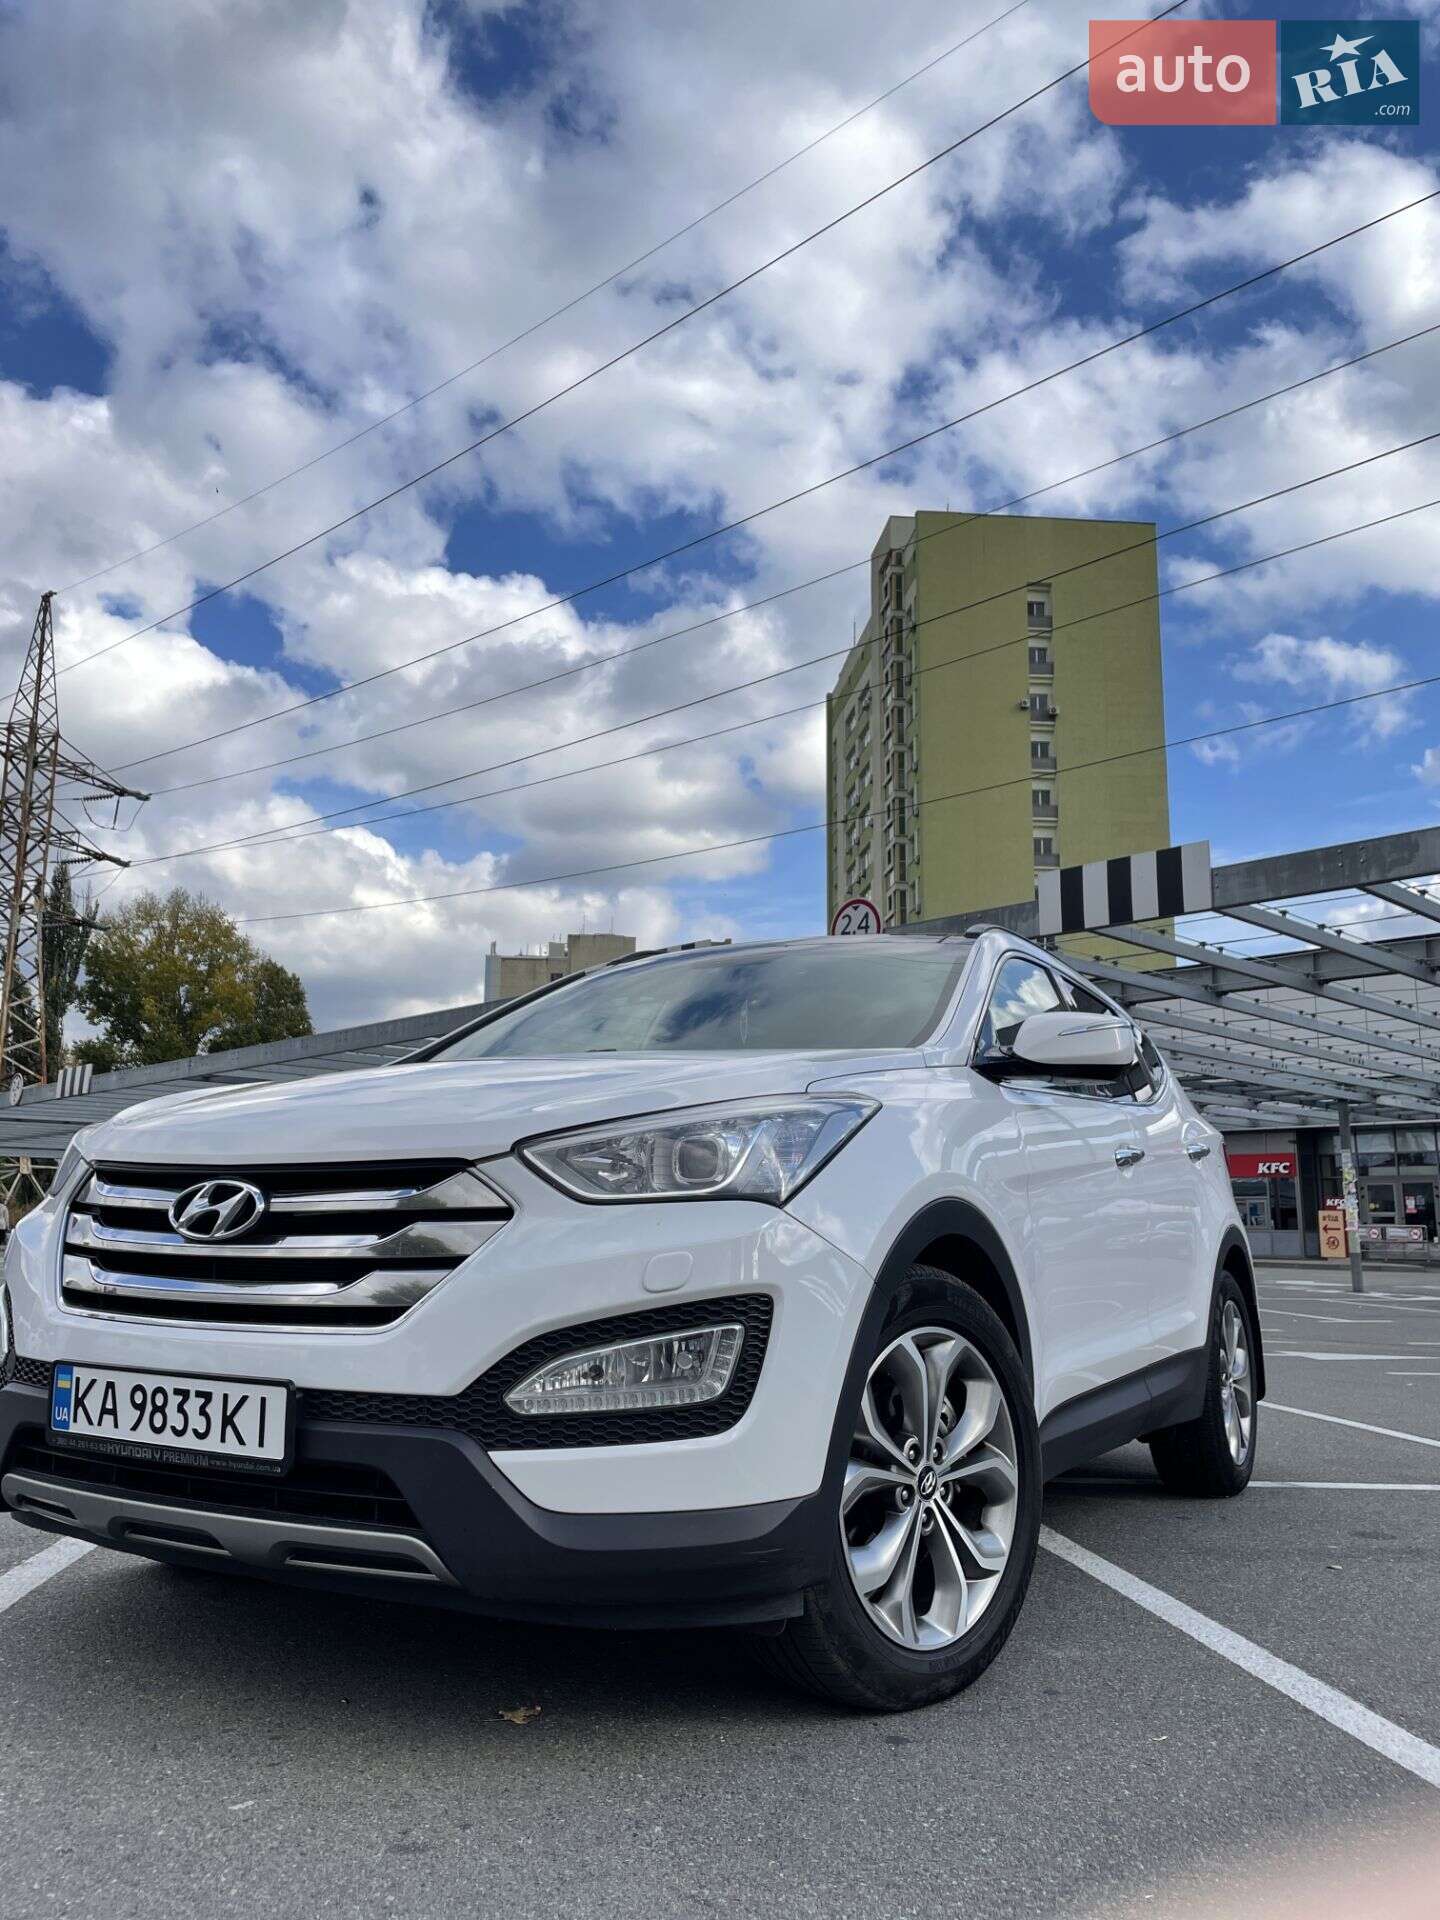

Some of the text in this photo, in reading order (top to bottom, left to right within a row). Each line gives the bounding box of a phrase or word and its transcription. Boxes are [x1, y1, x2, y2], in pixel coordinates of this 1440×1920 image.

[841, 911, 870, 935] 2.4
[1257, 1162, 1290, 1174] KFC
[55, 1406, 69, 1422] UA
[73, 1376, 119, 1429] KA
[129, 1383, 213, 1440] 9833
